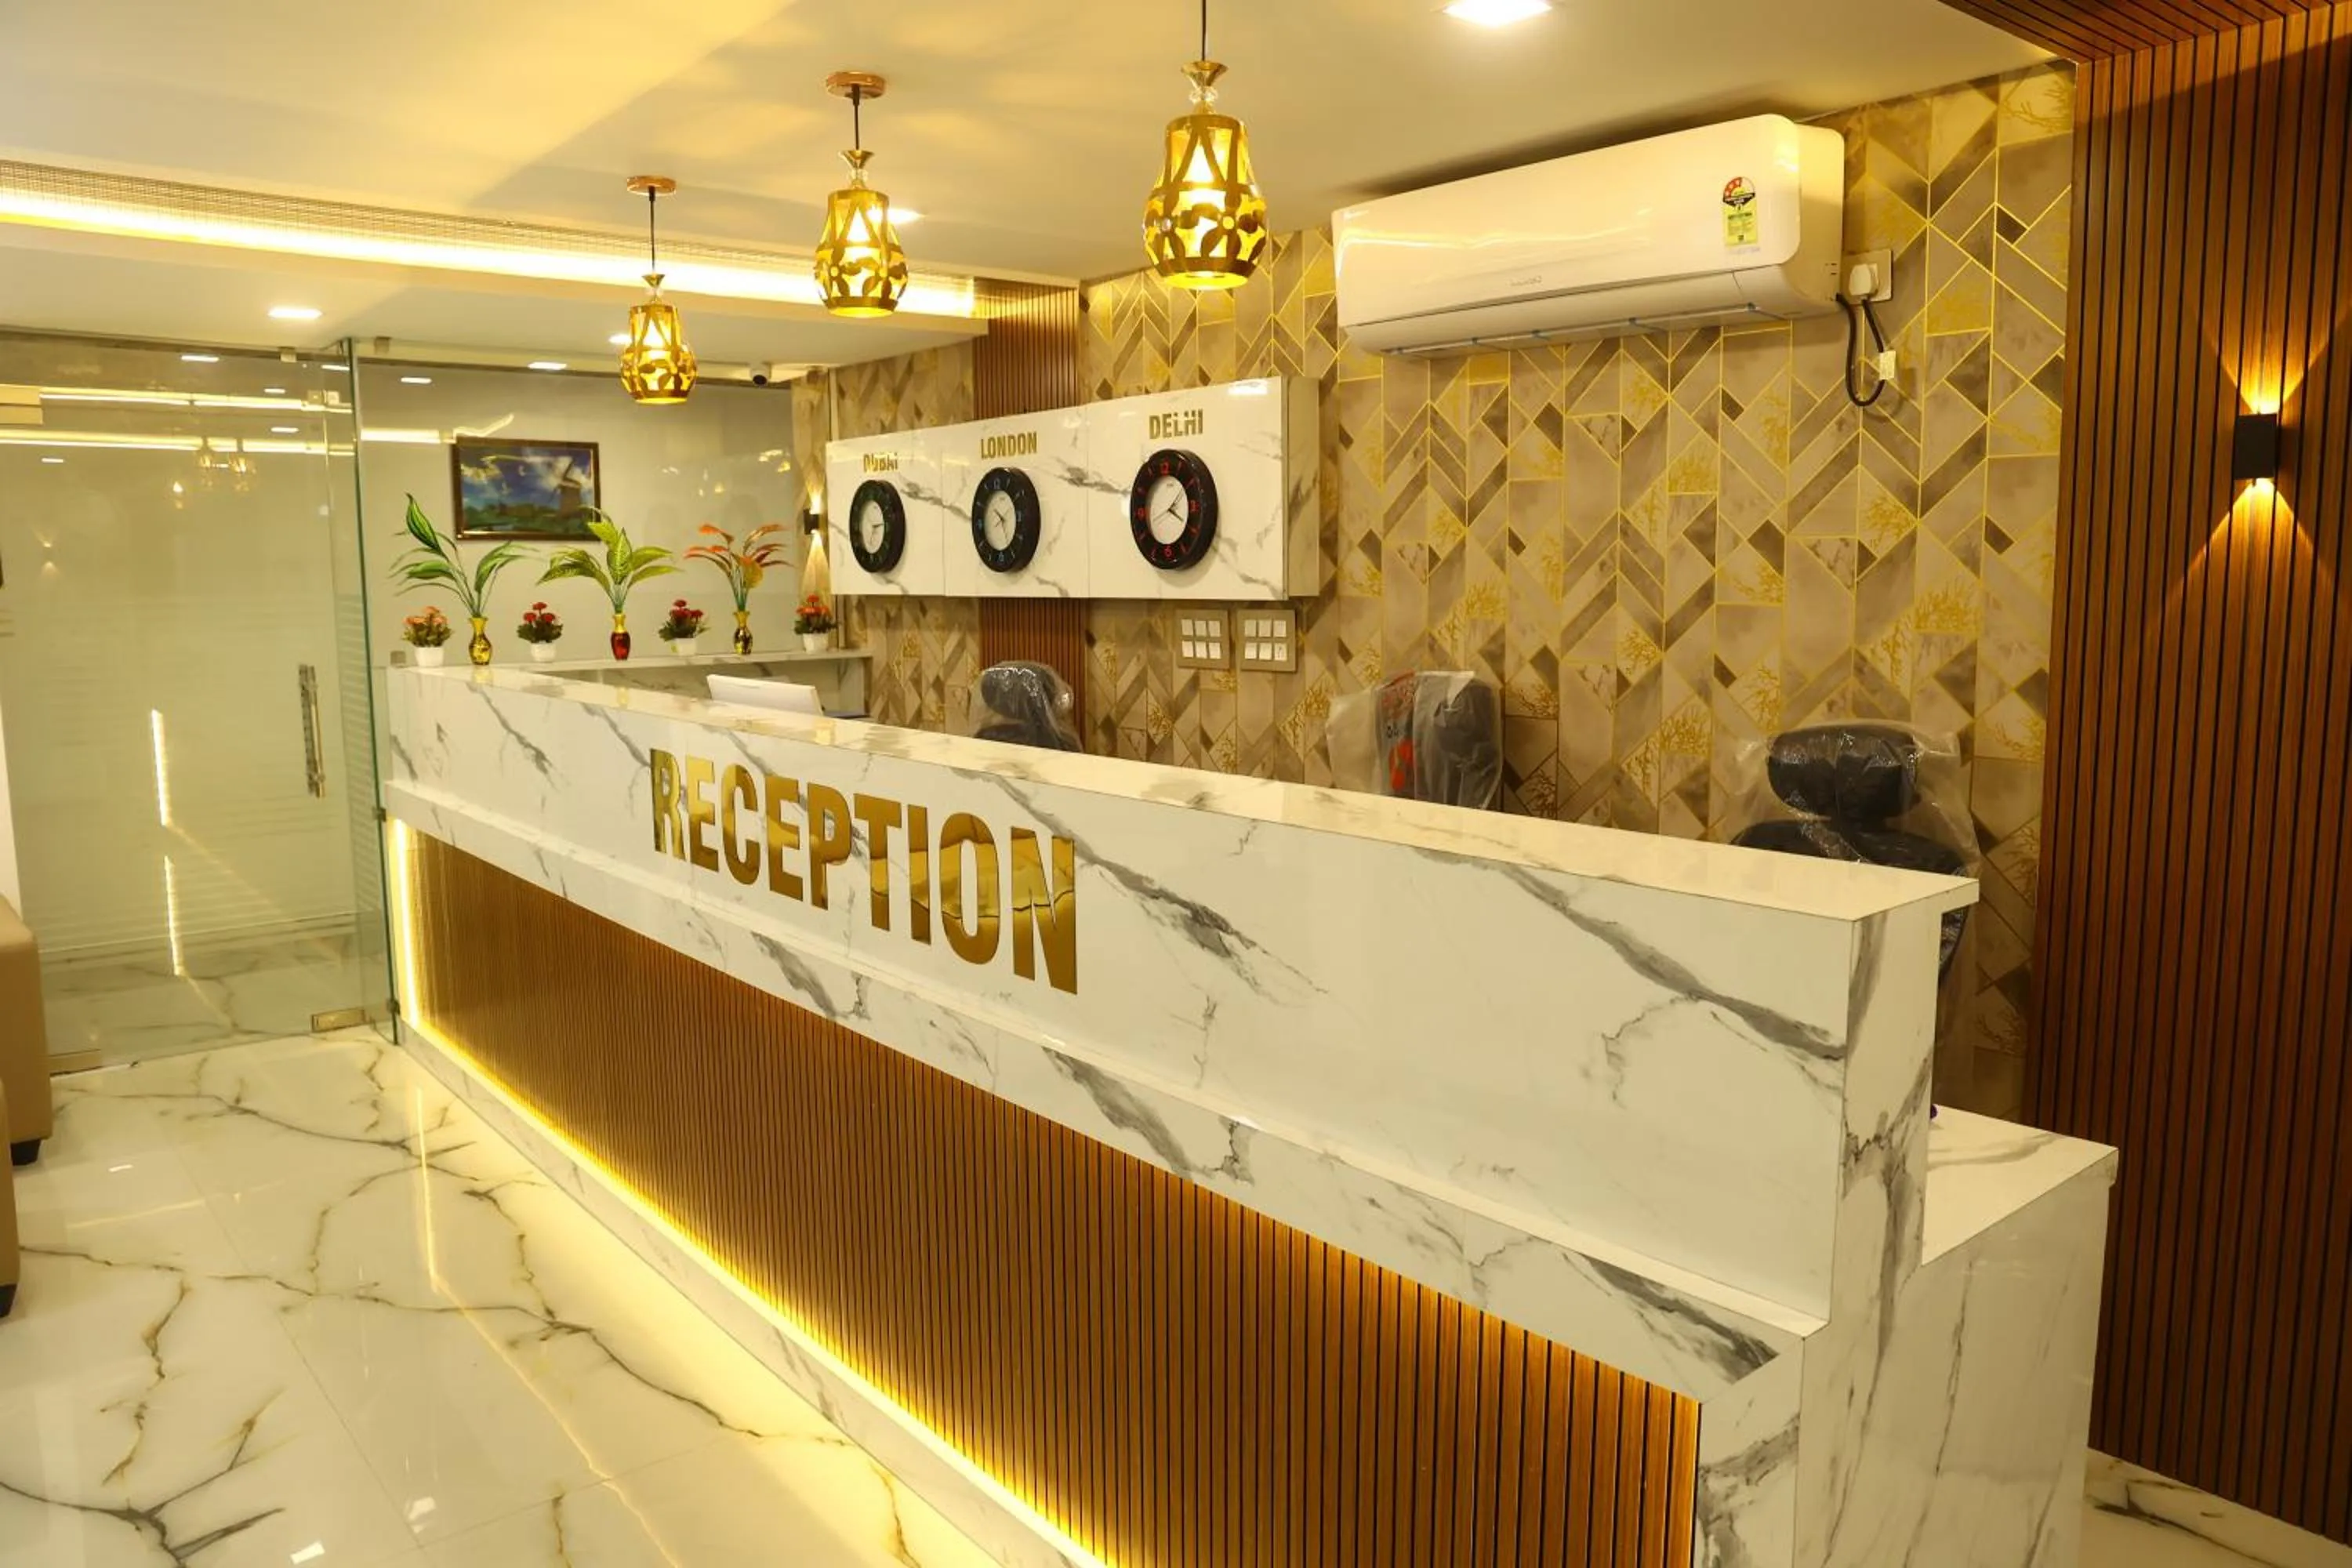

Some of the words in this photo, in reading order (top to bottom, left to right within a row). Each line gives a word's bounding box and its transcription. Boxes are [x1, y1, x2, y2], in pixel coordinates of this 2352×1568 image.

[1149, 408, 1203, 440] DELHI
[981, 431, 1036, 459] LONDON
[650, 748, 1077, 995] RECEPTION
